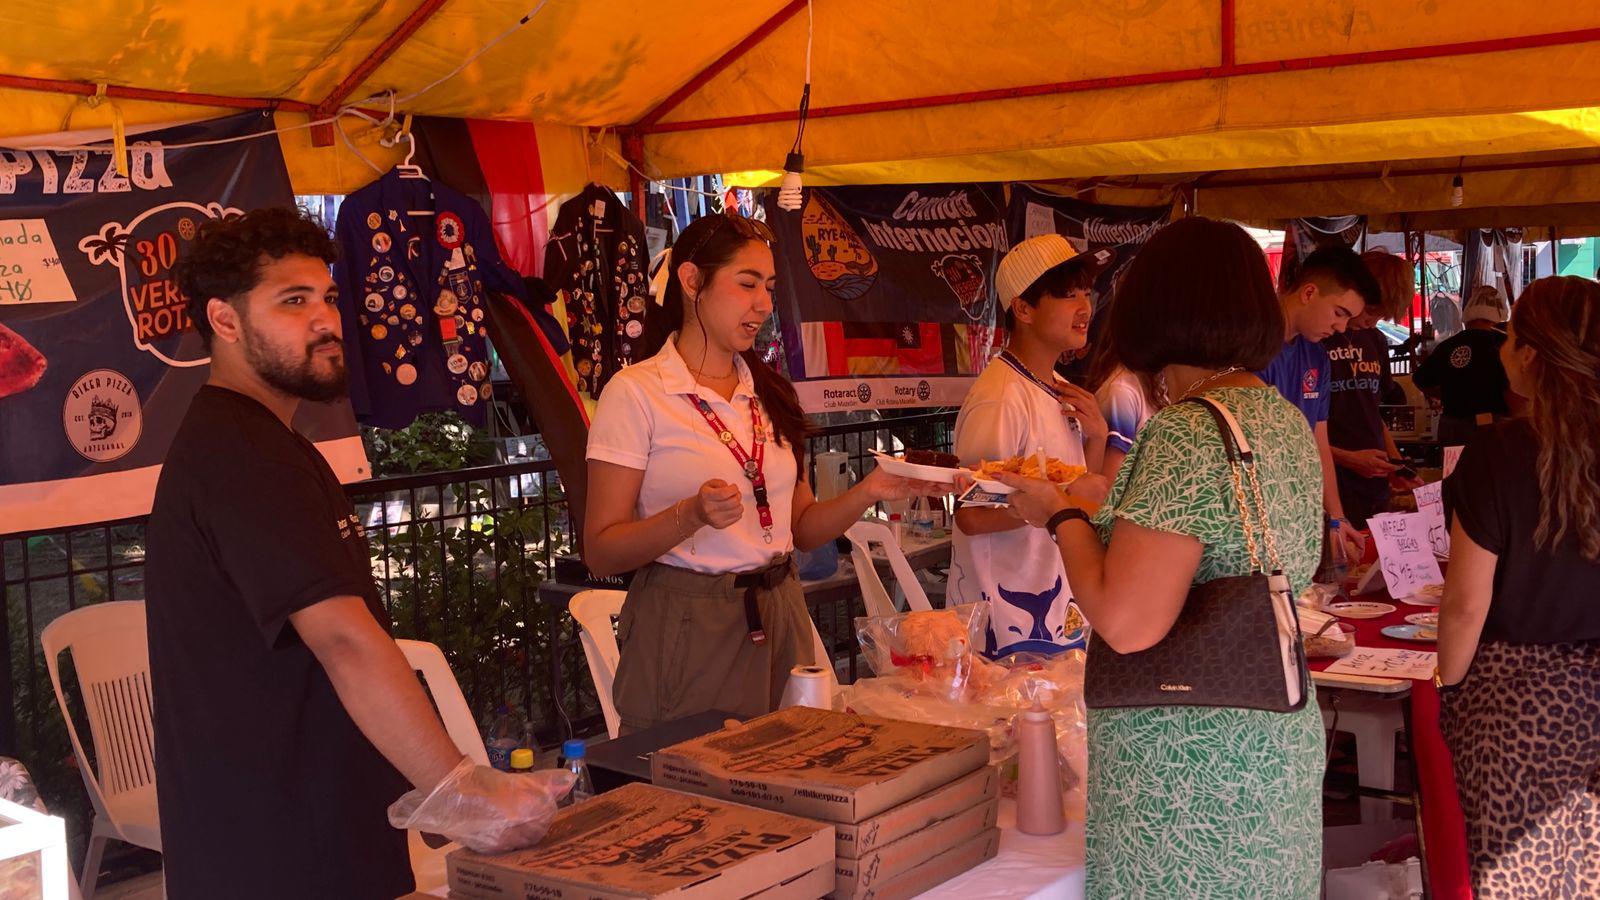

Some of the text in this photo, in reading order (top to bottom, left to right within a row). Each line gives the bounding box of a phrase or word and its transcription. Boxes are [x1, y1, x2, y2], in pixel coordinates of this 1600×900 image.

[137, 232, 177, 277] 30
[131, 280, 191, 312] VER
[138, 304, 192, 340] ROT
[72, 378, 132, 399] BIKER PIZZA
[824, 389, 857, 399] Rotaract
[895, 386, 916, 396] Rotary
[661, 833, 791, 877] PIZZA
